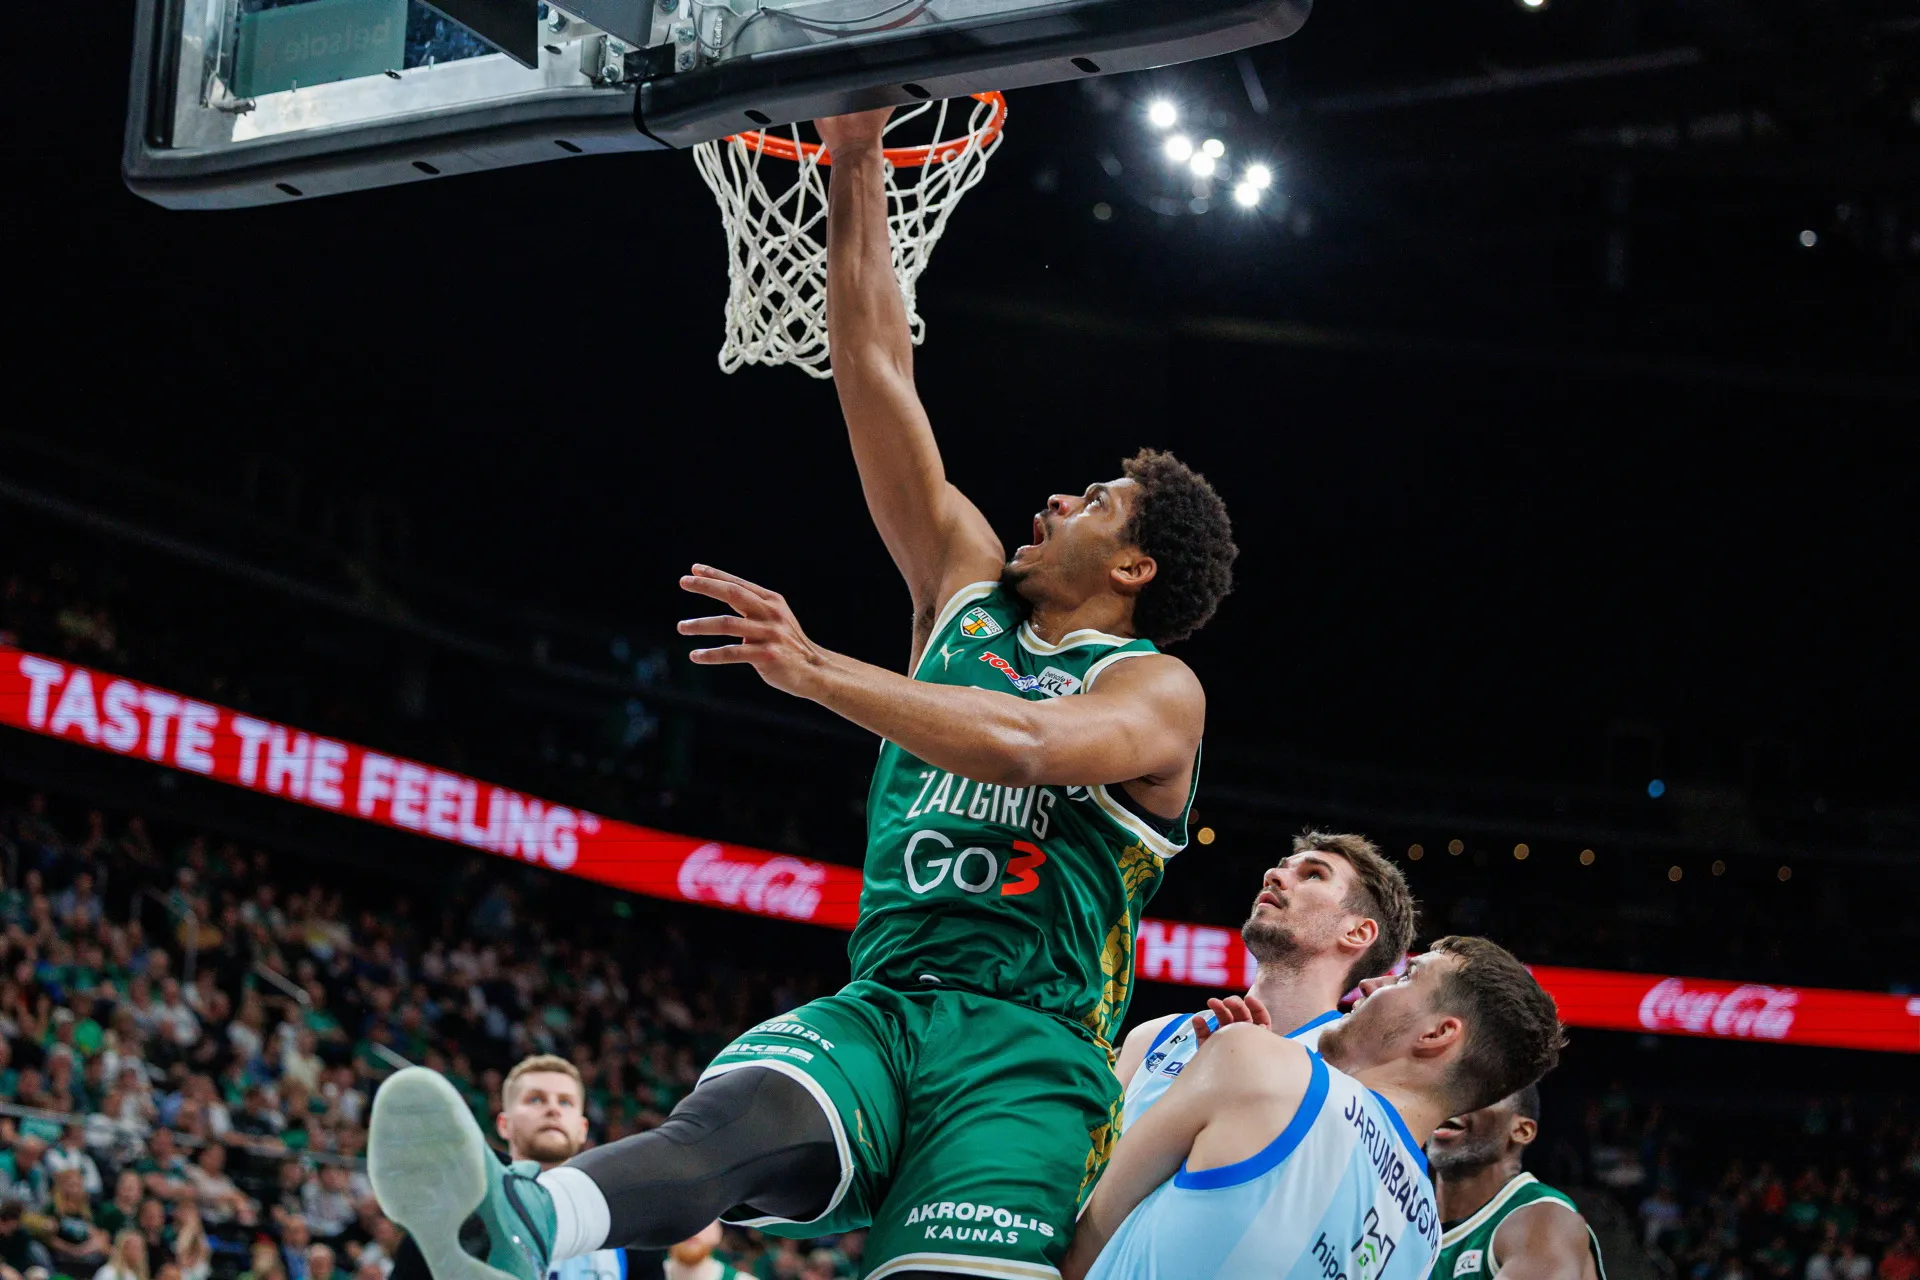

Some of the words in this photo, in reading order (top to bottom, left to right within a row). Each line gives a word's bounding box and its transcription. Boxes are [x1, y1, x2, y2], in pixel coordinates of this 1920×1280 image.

[1038, 677, 1063, 696] LKL
[18, 654, 220, 776] TASTE
[231, 712, 349, 811] THE
[1344, 1095, 1438, 1256] JARUMBAUSK
[904, 1201, 1055, 1238] AKROPOLIS
[924, 1225, 1019, 1245] KAUNAS
